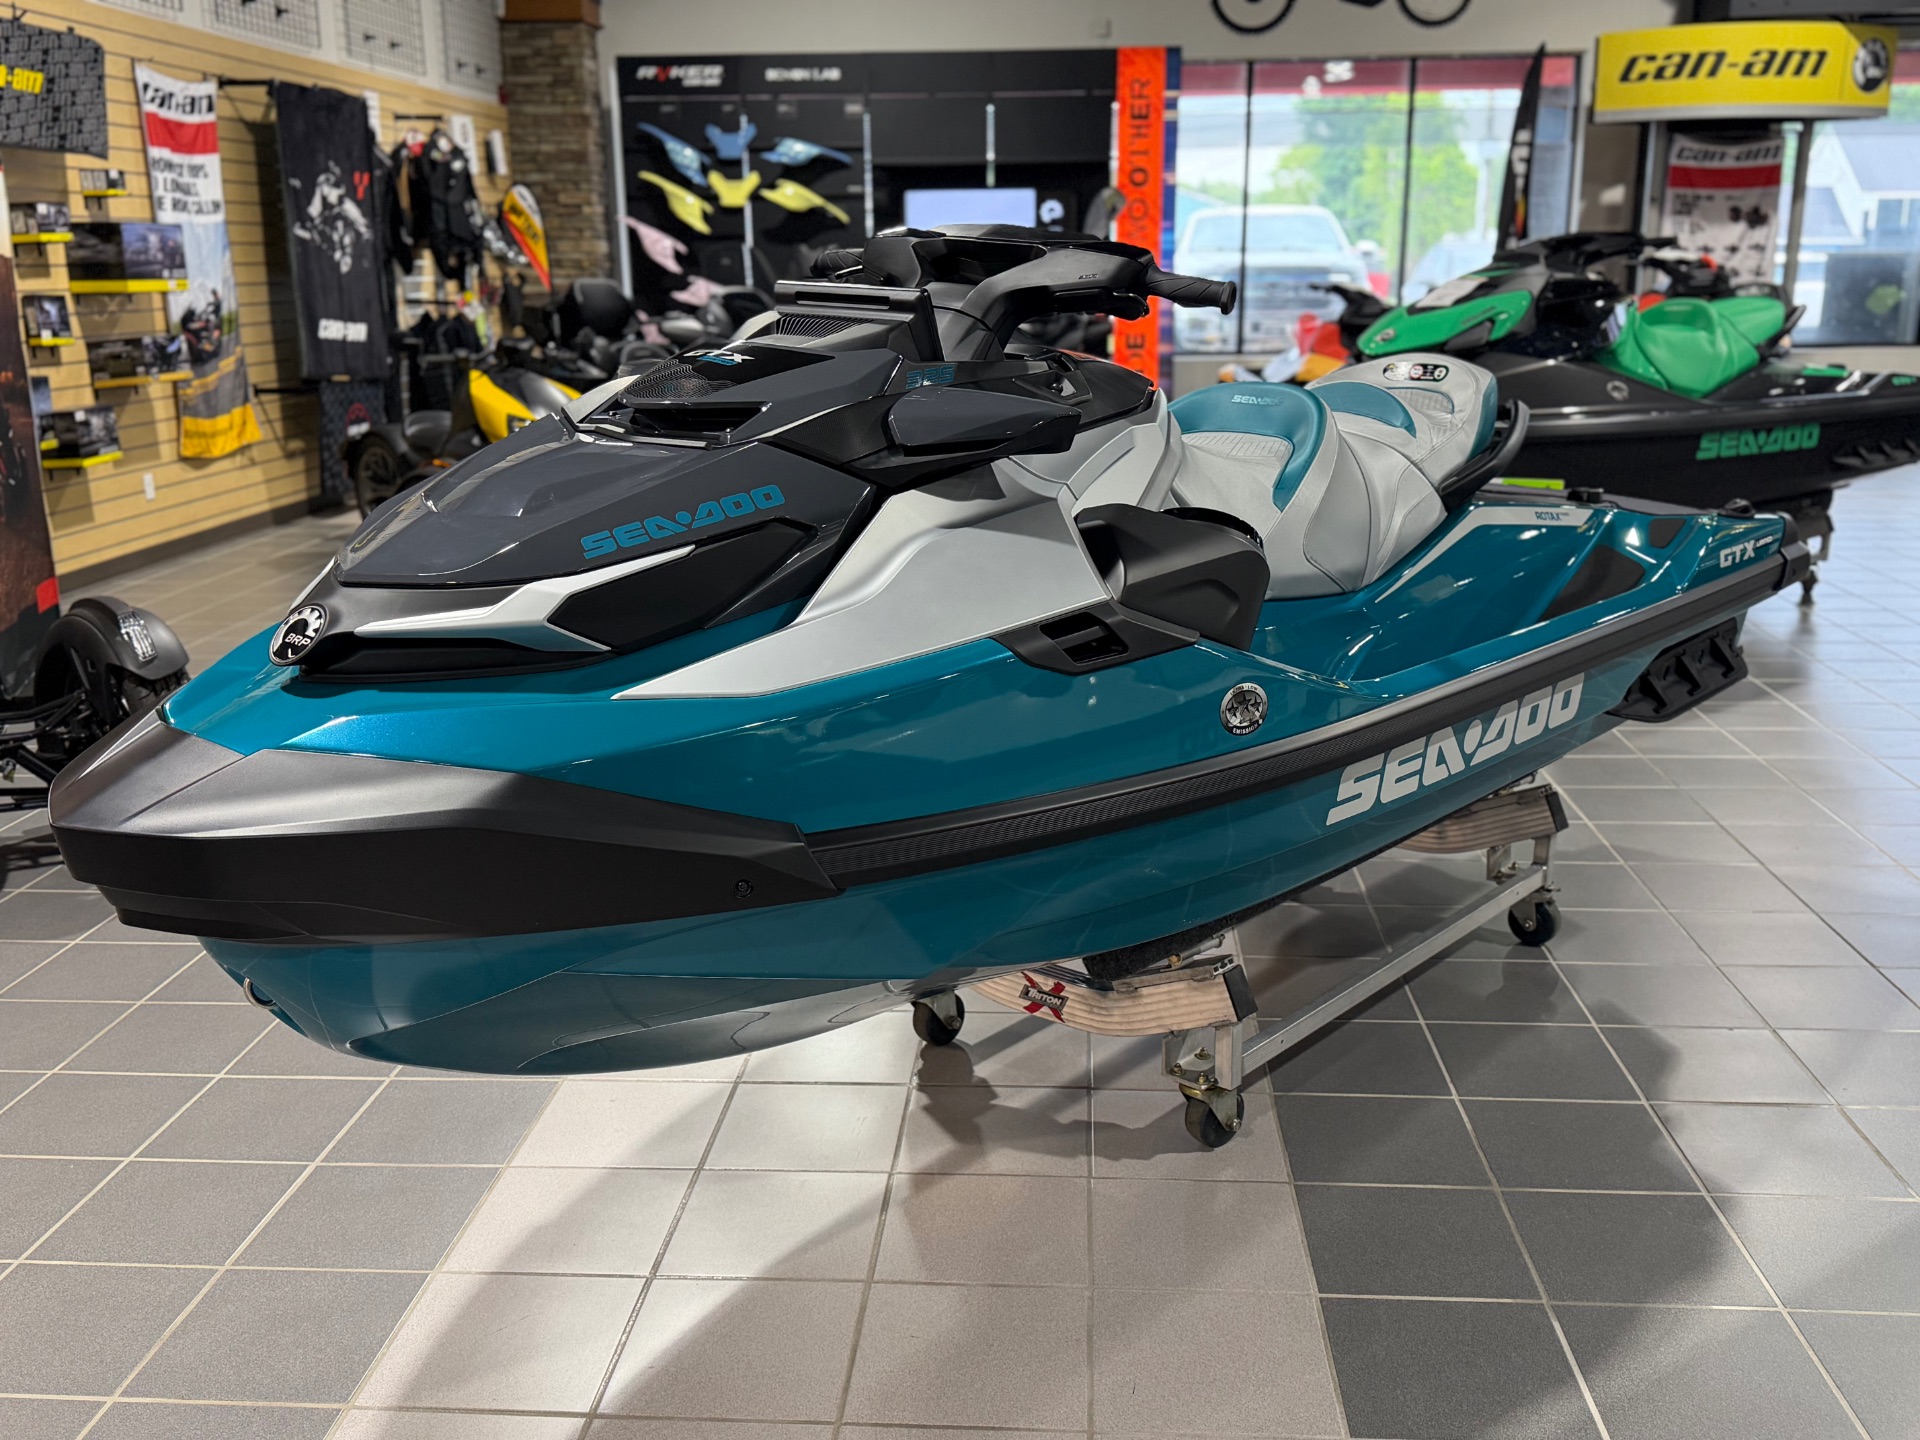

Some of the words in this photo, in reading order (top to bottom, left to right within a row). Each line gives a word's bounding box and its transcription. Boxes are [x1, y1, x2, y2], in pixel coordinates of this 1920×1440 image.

[812, 67, 842, 81] LAB
[1618, 50, 1828, 83] can-am
[1129, 79, 1152, 187] OTHER
[1535, 511, 1561, 521] ROTAX
[1720, 540, 1755, 568] GTX
[285, 633, 311, 646] BRP
[1027, 987, 1063, 1006] TRITON
